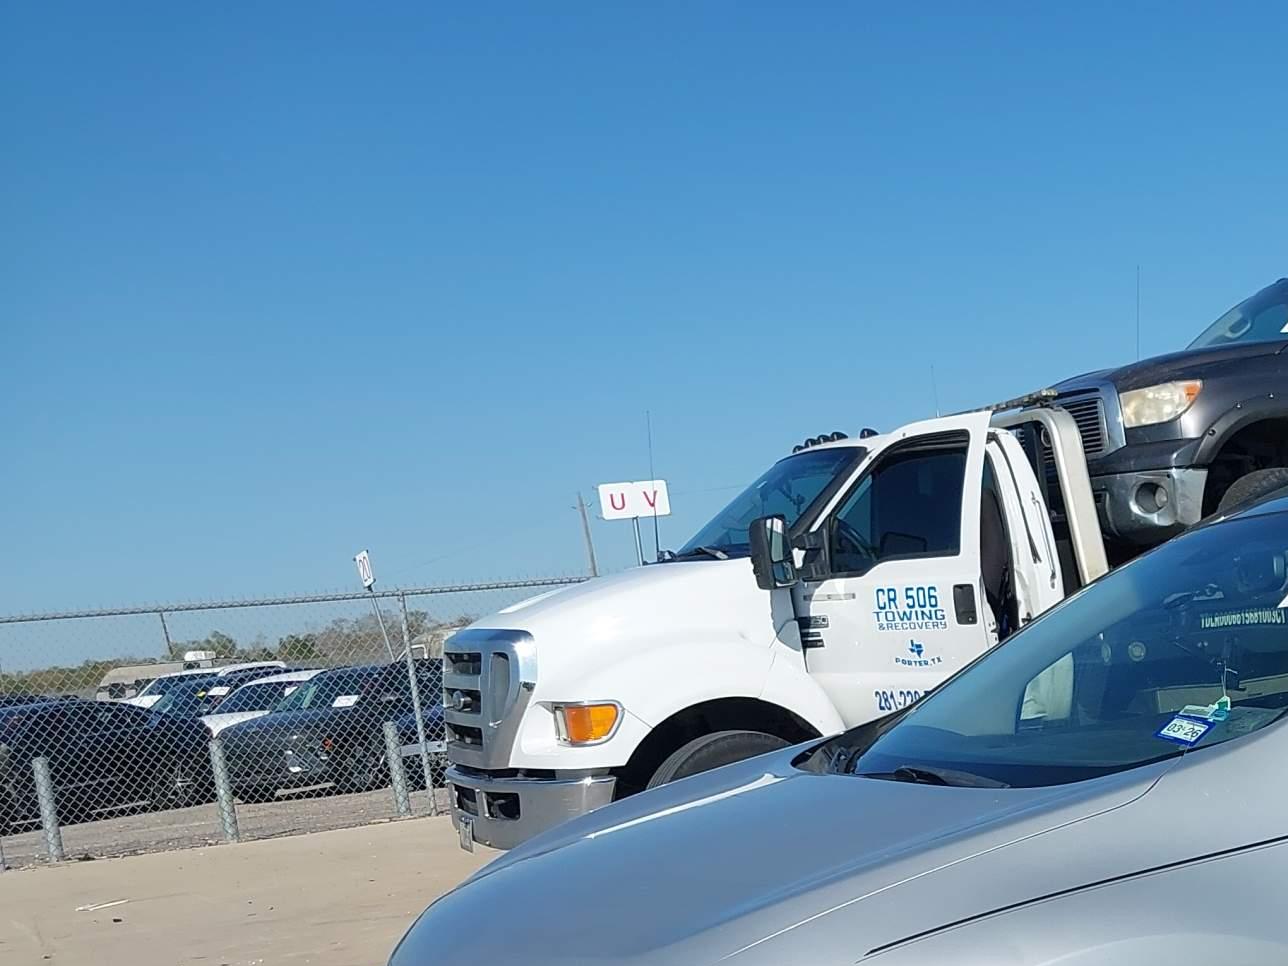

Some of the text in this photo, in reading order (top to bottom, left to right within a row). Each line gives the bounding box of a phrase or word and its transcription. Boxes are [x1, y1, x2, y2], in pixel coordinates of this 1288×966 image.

[610, 490, 657, 510] U V
[358, 556, 372, 582] 20
[876, 586, 938, 610] CR 506
[873, 609, 945, 622] TOWING
[1166, 723, 1183, 734] 03
[1183, 727, 1202, 738] 26
